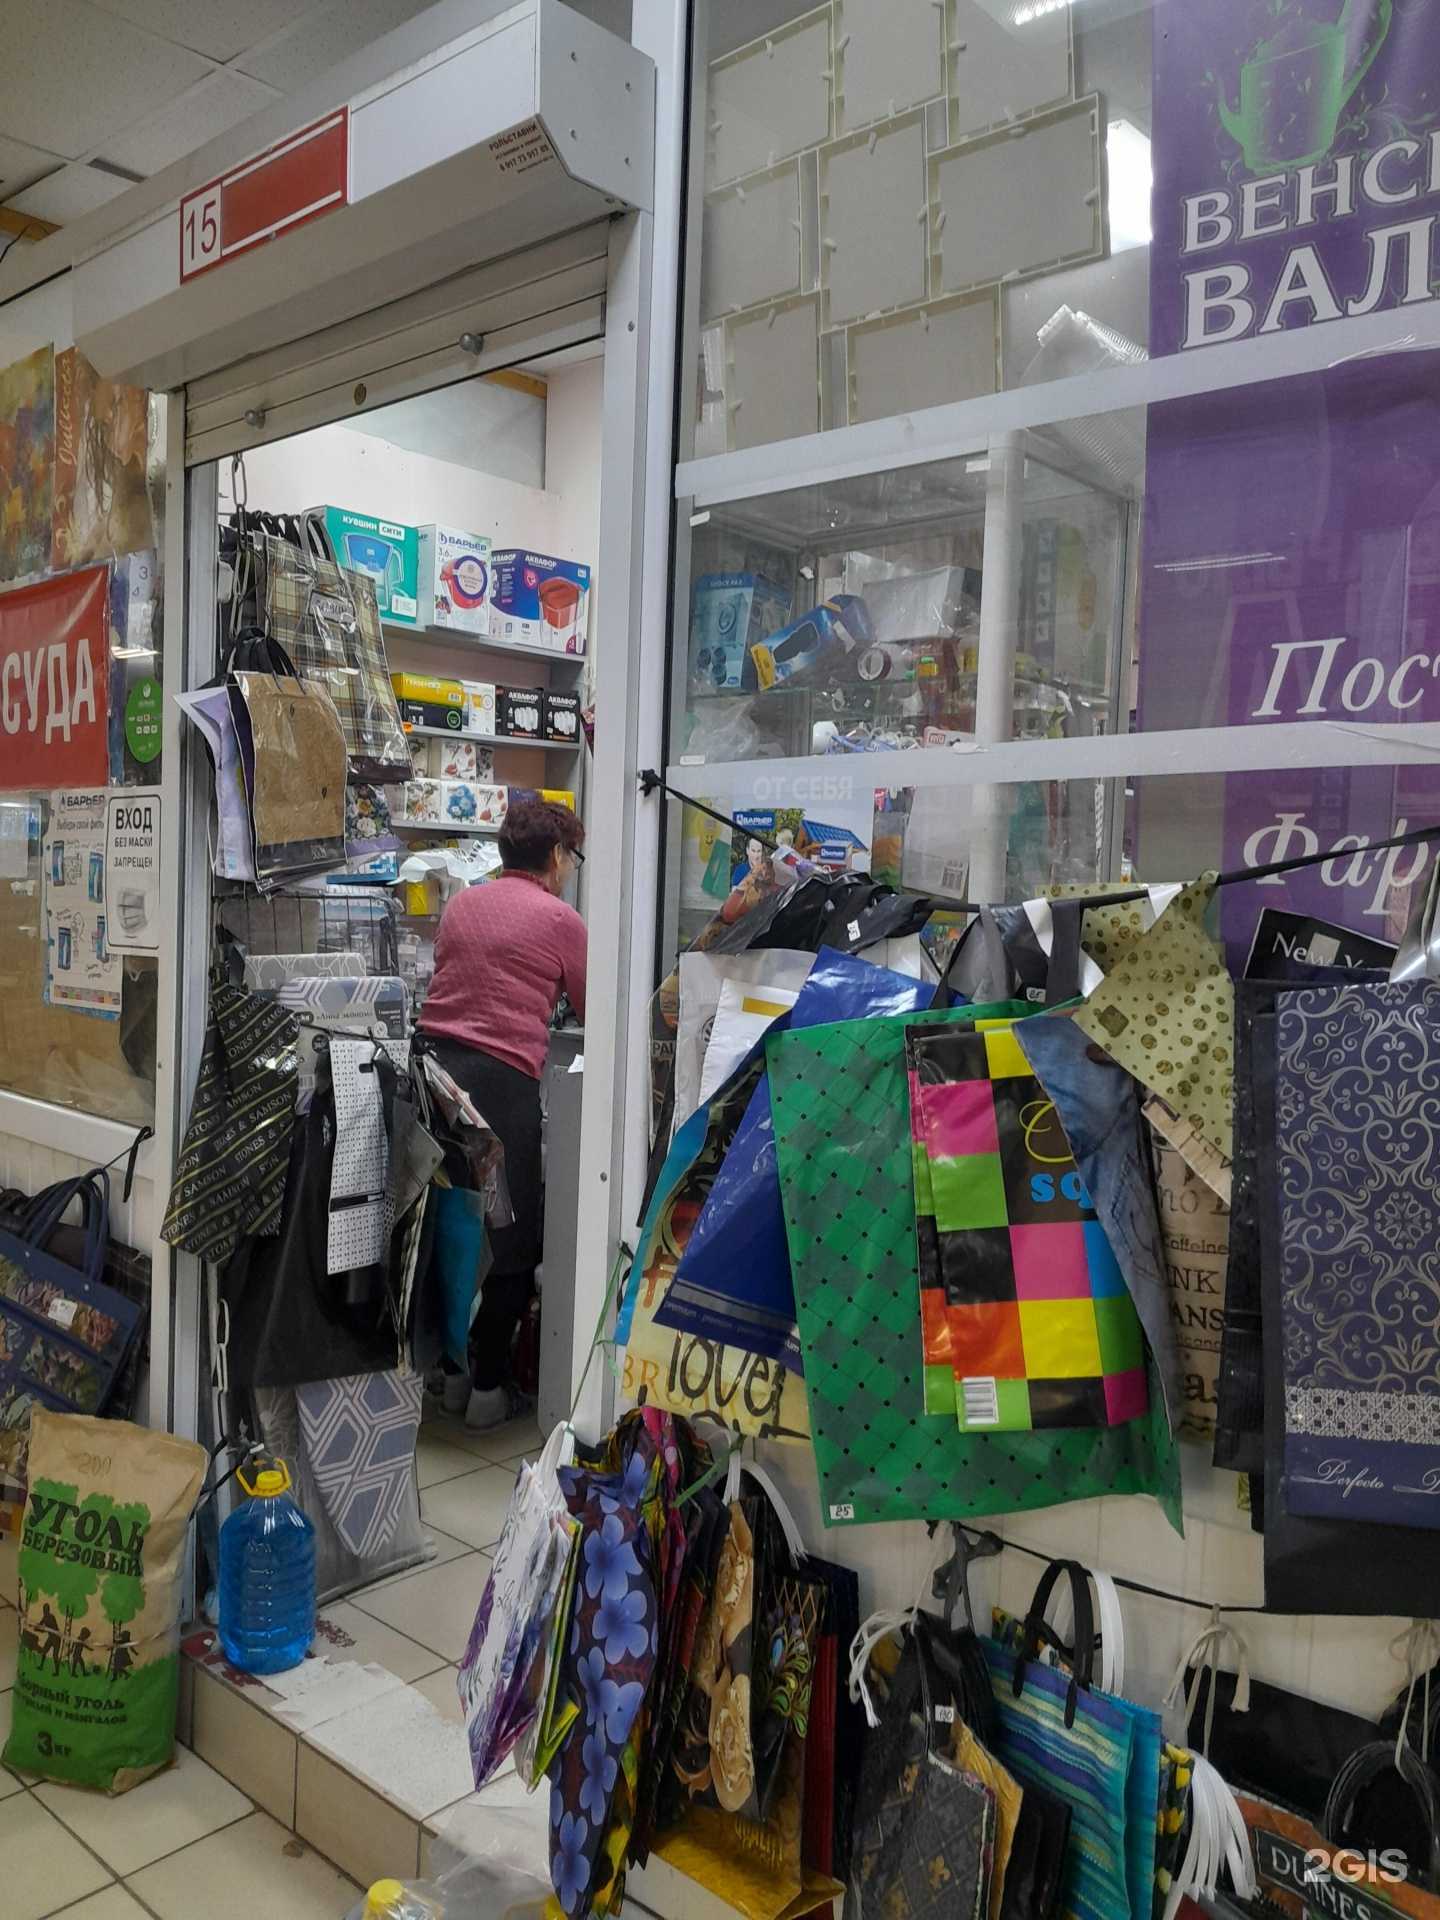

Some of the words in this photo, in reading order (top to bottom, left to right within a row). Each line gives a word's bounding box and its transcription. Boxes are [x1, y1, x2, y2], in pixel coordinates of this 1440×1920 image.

[1183, 132, 1440, 254] ВЕНС
[185, 199, 217, 261] 15
[1178, 216, 1433, 350] ВАЛ
[342, 515, 378, 531] КУВШИН
[381, 526, 403, 537] СИТИ
[525, 554, 557, 568] АКВАФОР
[1252, 637, 1440, 716] Пос
[2, 638, 96, 744] СУДА
[508, 691, 539, 702] АКВАФОР
[548, 695, 577, 705] АКВАФОР
[753, 777, 783, 800] ОТ
[792, 776, 853, 801] СЕБЯ
[116, 807, 152, 833] ВХОД
[115, 837, 127, 847] БЕЗ
[129, 837, 153, 848] МАСКИ
[114, 856, 153, 869] ЗАПРЕЩЕН
[1291, 1458, 1385, 1498] Perfecto
[29, 1493, 145, 1554] УГОЛЬ
